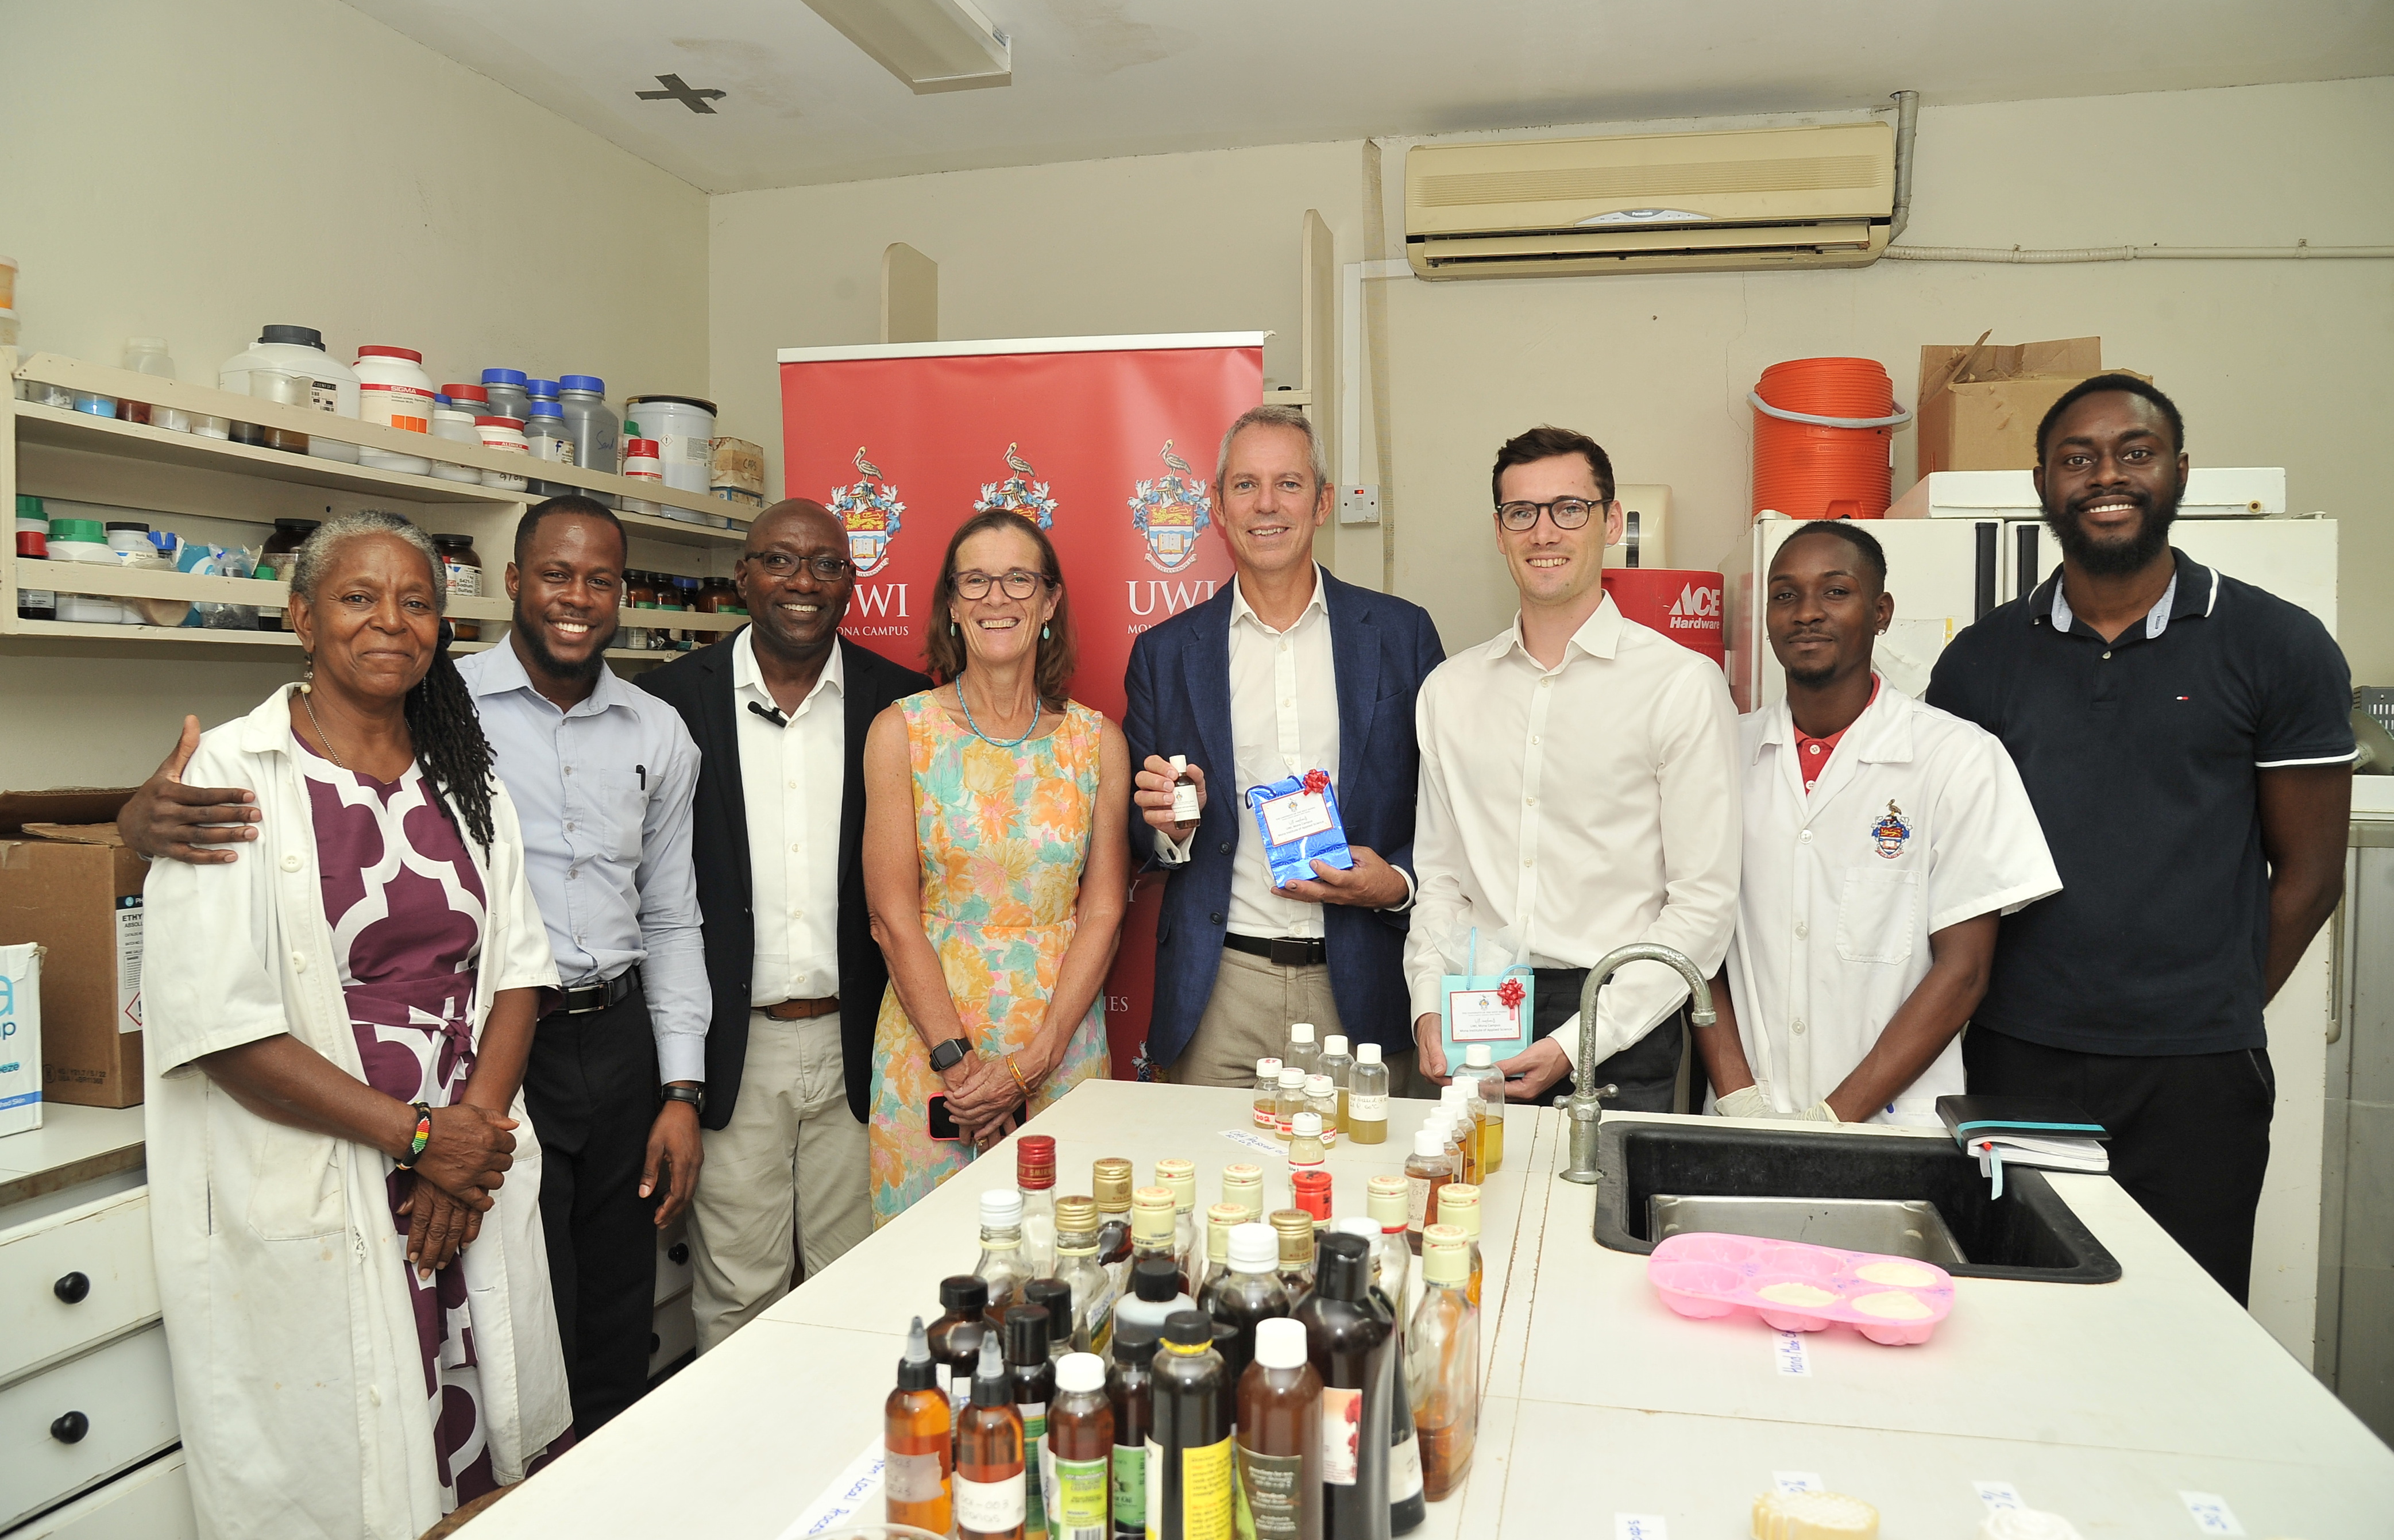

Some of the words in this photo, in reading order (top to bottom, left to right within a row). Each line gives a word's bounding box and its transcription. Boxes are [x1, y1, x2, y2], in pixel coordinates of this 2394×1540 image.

[844, 584, 910, 617] WI
[1669, 581, 1720, 616] ACE
[1670, 616, 1720, 629] Hardware
[836, 626, 860, 636] ONA
[862, 626, 909, 636] CAMPUS
[122, 913, 142, 922] ETHY
